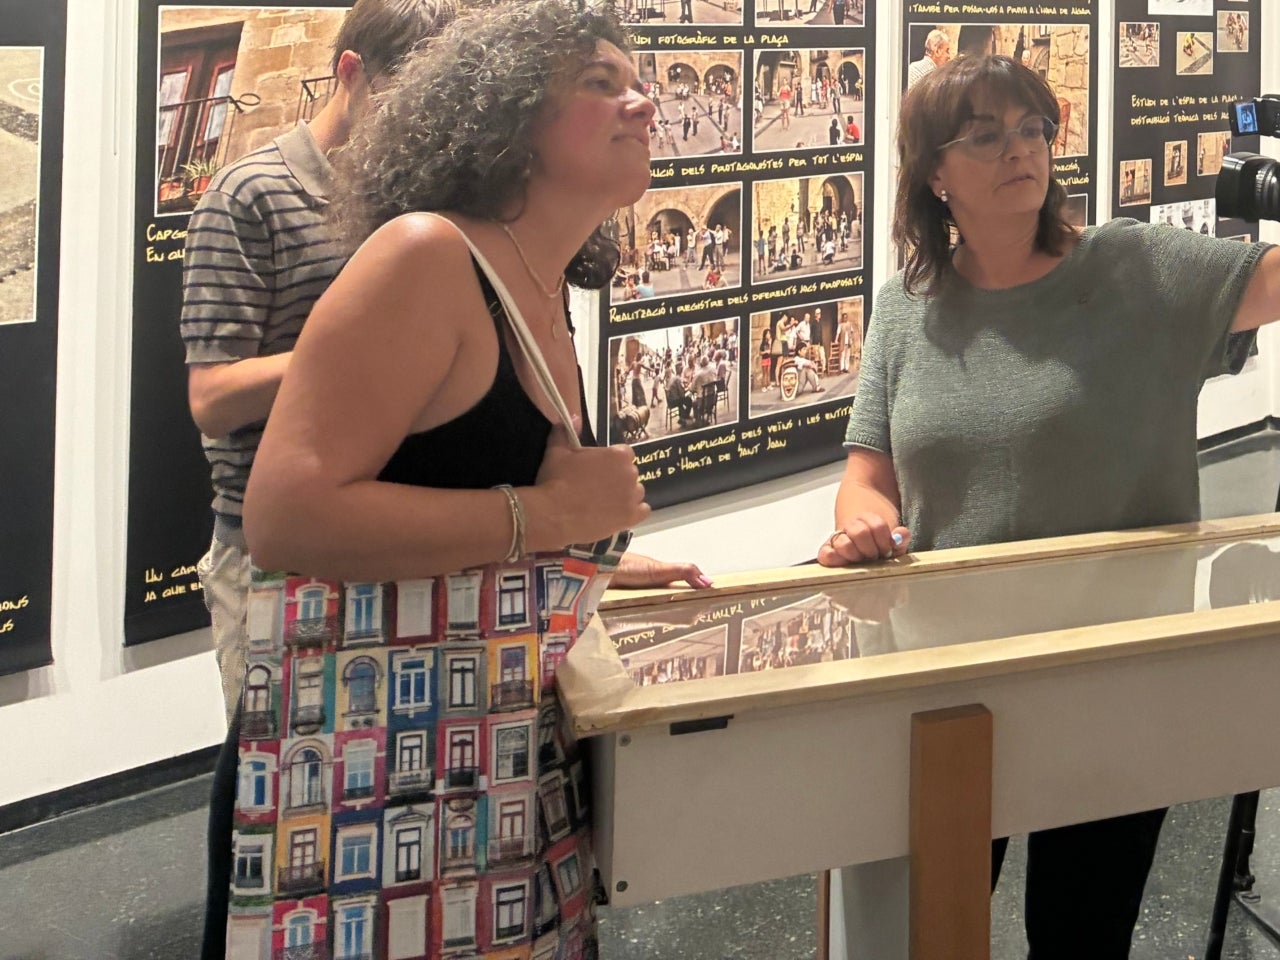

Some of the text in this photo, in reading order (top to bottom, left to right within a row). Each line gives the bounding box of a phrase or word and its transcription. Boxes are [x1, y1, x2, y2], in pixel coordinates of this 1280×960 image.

[724, 35, 736, 45] DE
[744, 34, 755, 44] LA
[682, 164, 706, 176] DELS
[789, 157, 807, 168] PER
[812, 154, 829, 165] TOT
